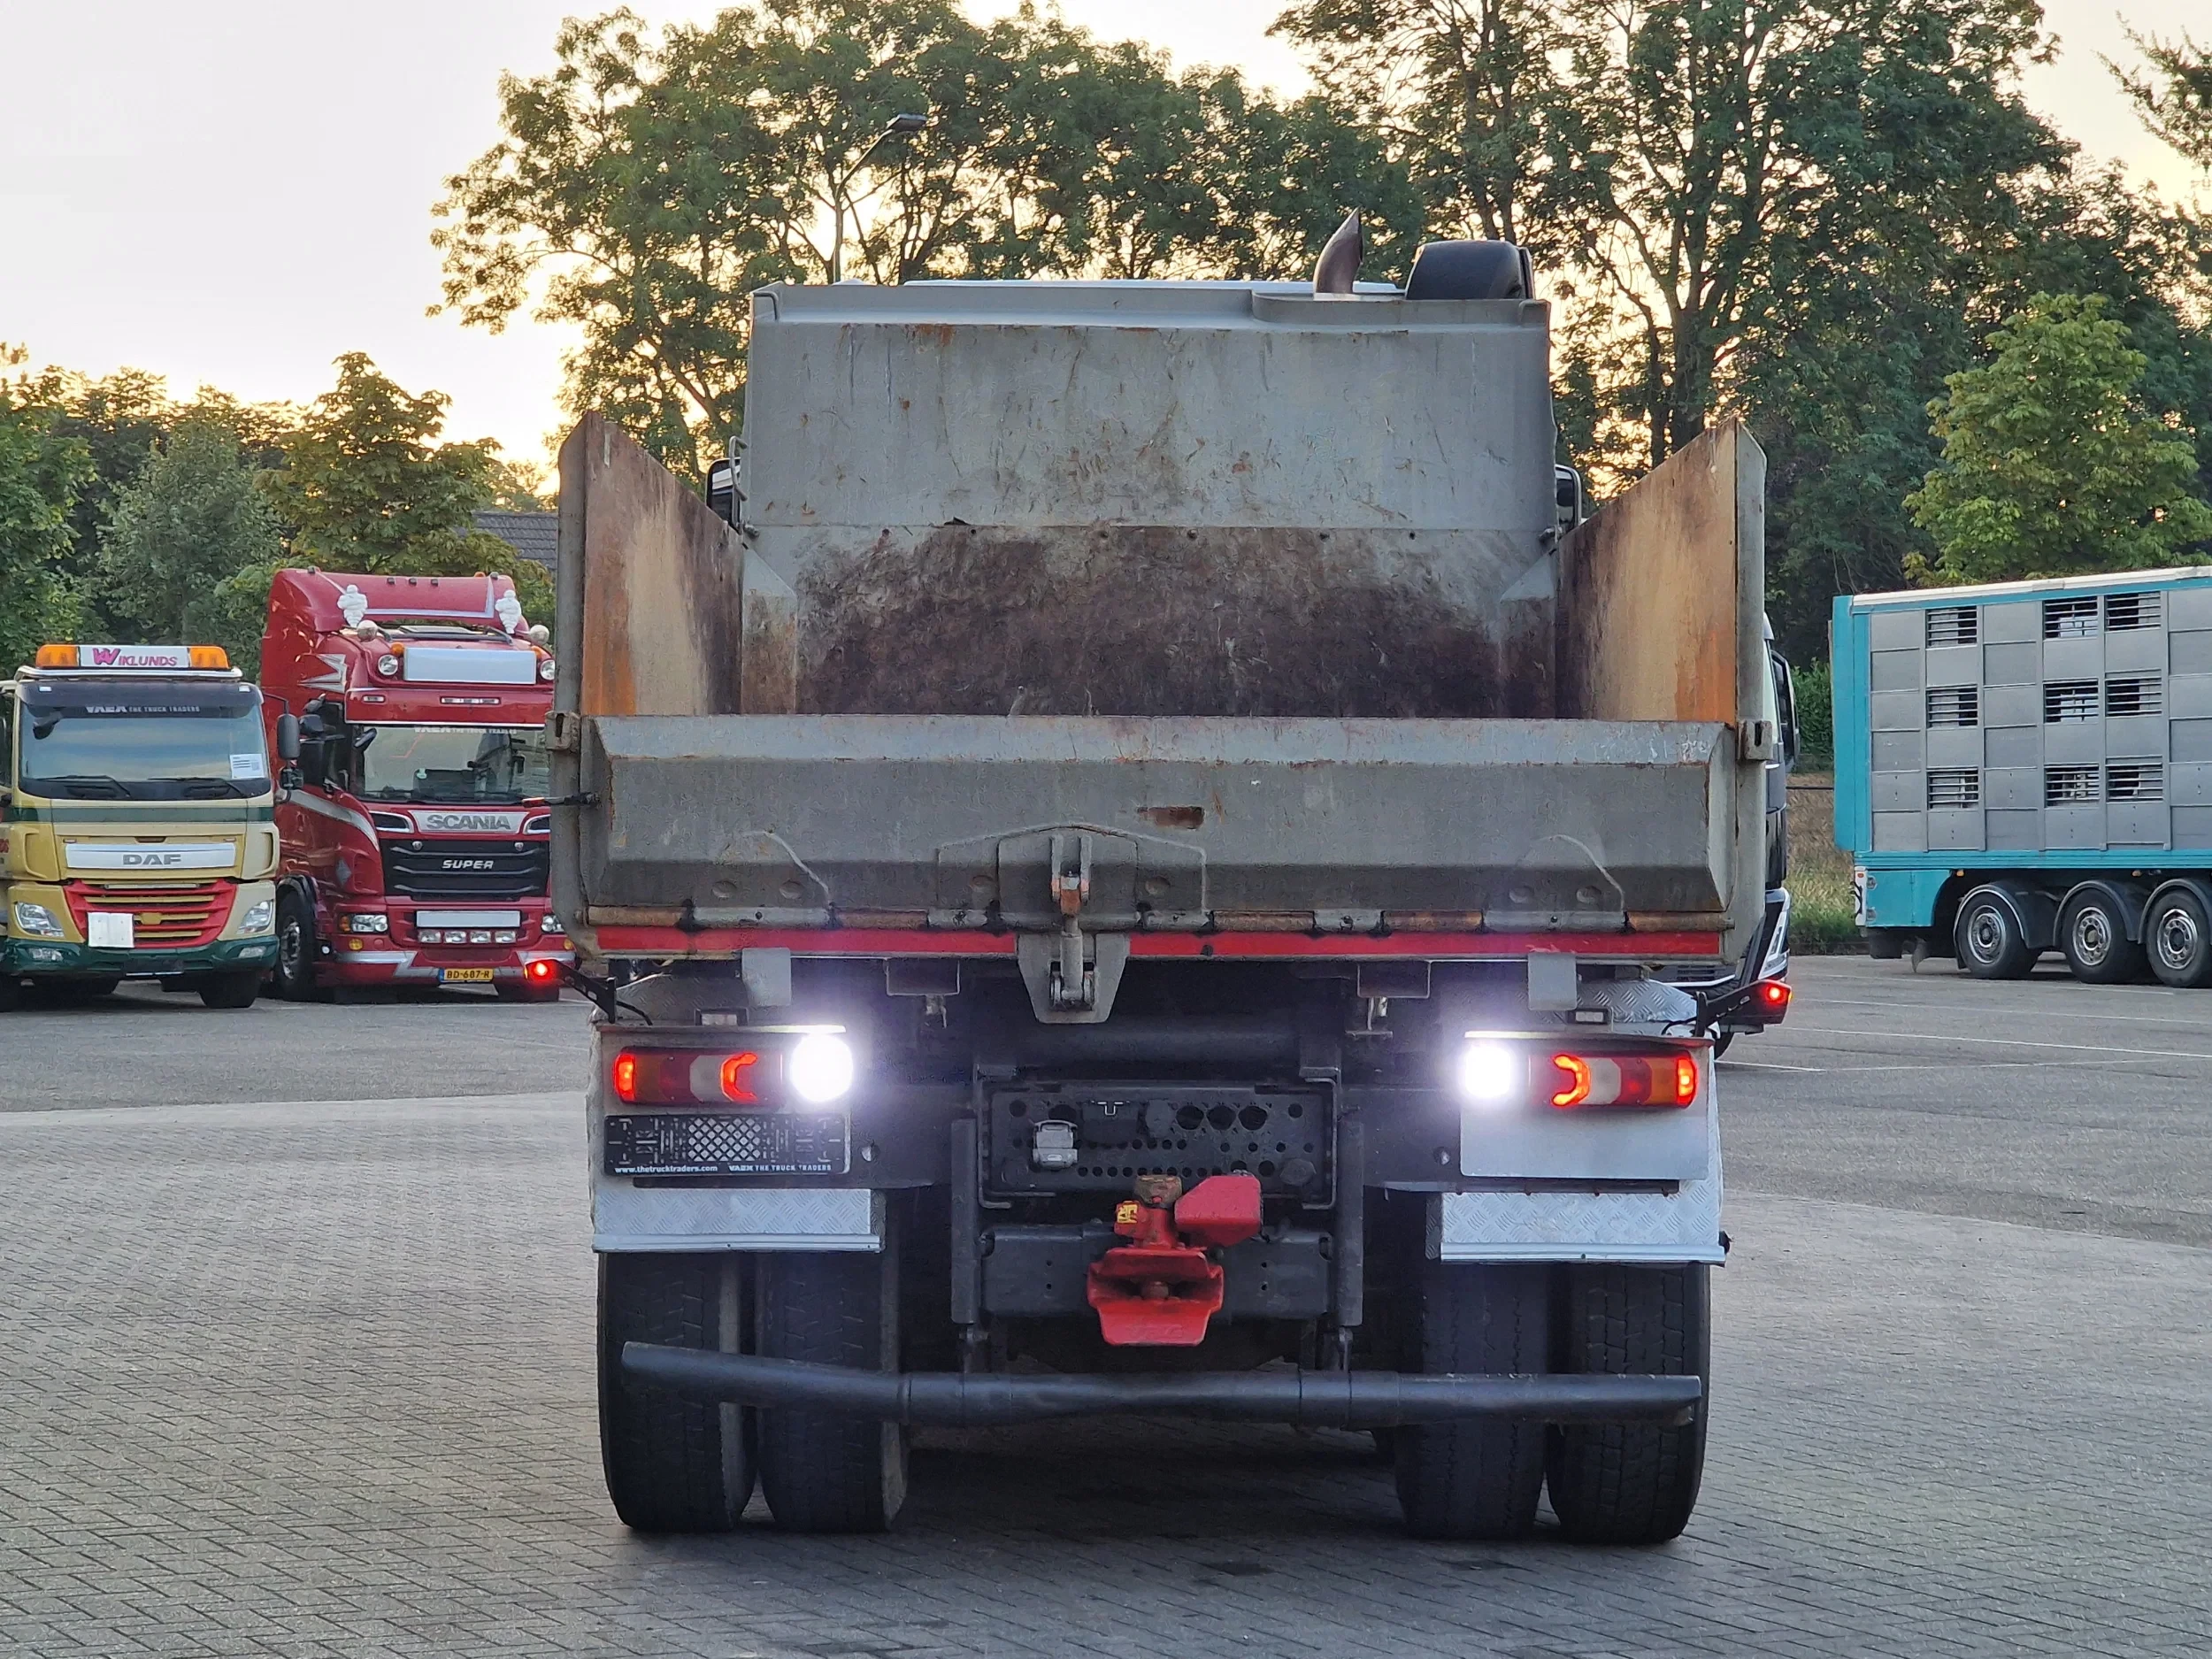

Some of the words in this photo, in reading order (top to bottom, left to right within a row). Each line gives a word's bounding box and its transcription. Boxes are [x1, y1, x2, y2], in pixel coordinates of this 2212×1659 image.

[426, 814, 511, 830] SCANIA
[122, 854, 181, 865] DAF
[442, 859, 494, 869] SUPER
[615, 1164, 718, 1174] www.thetrucktraders.com
